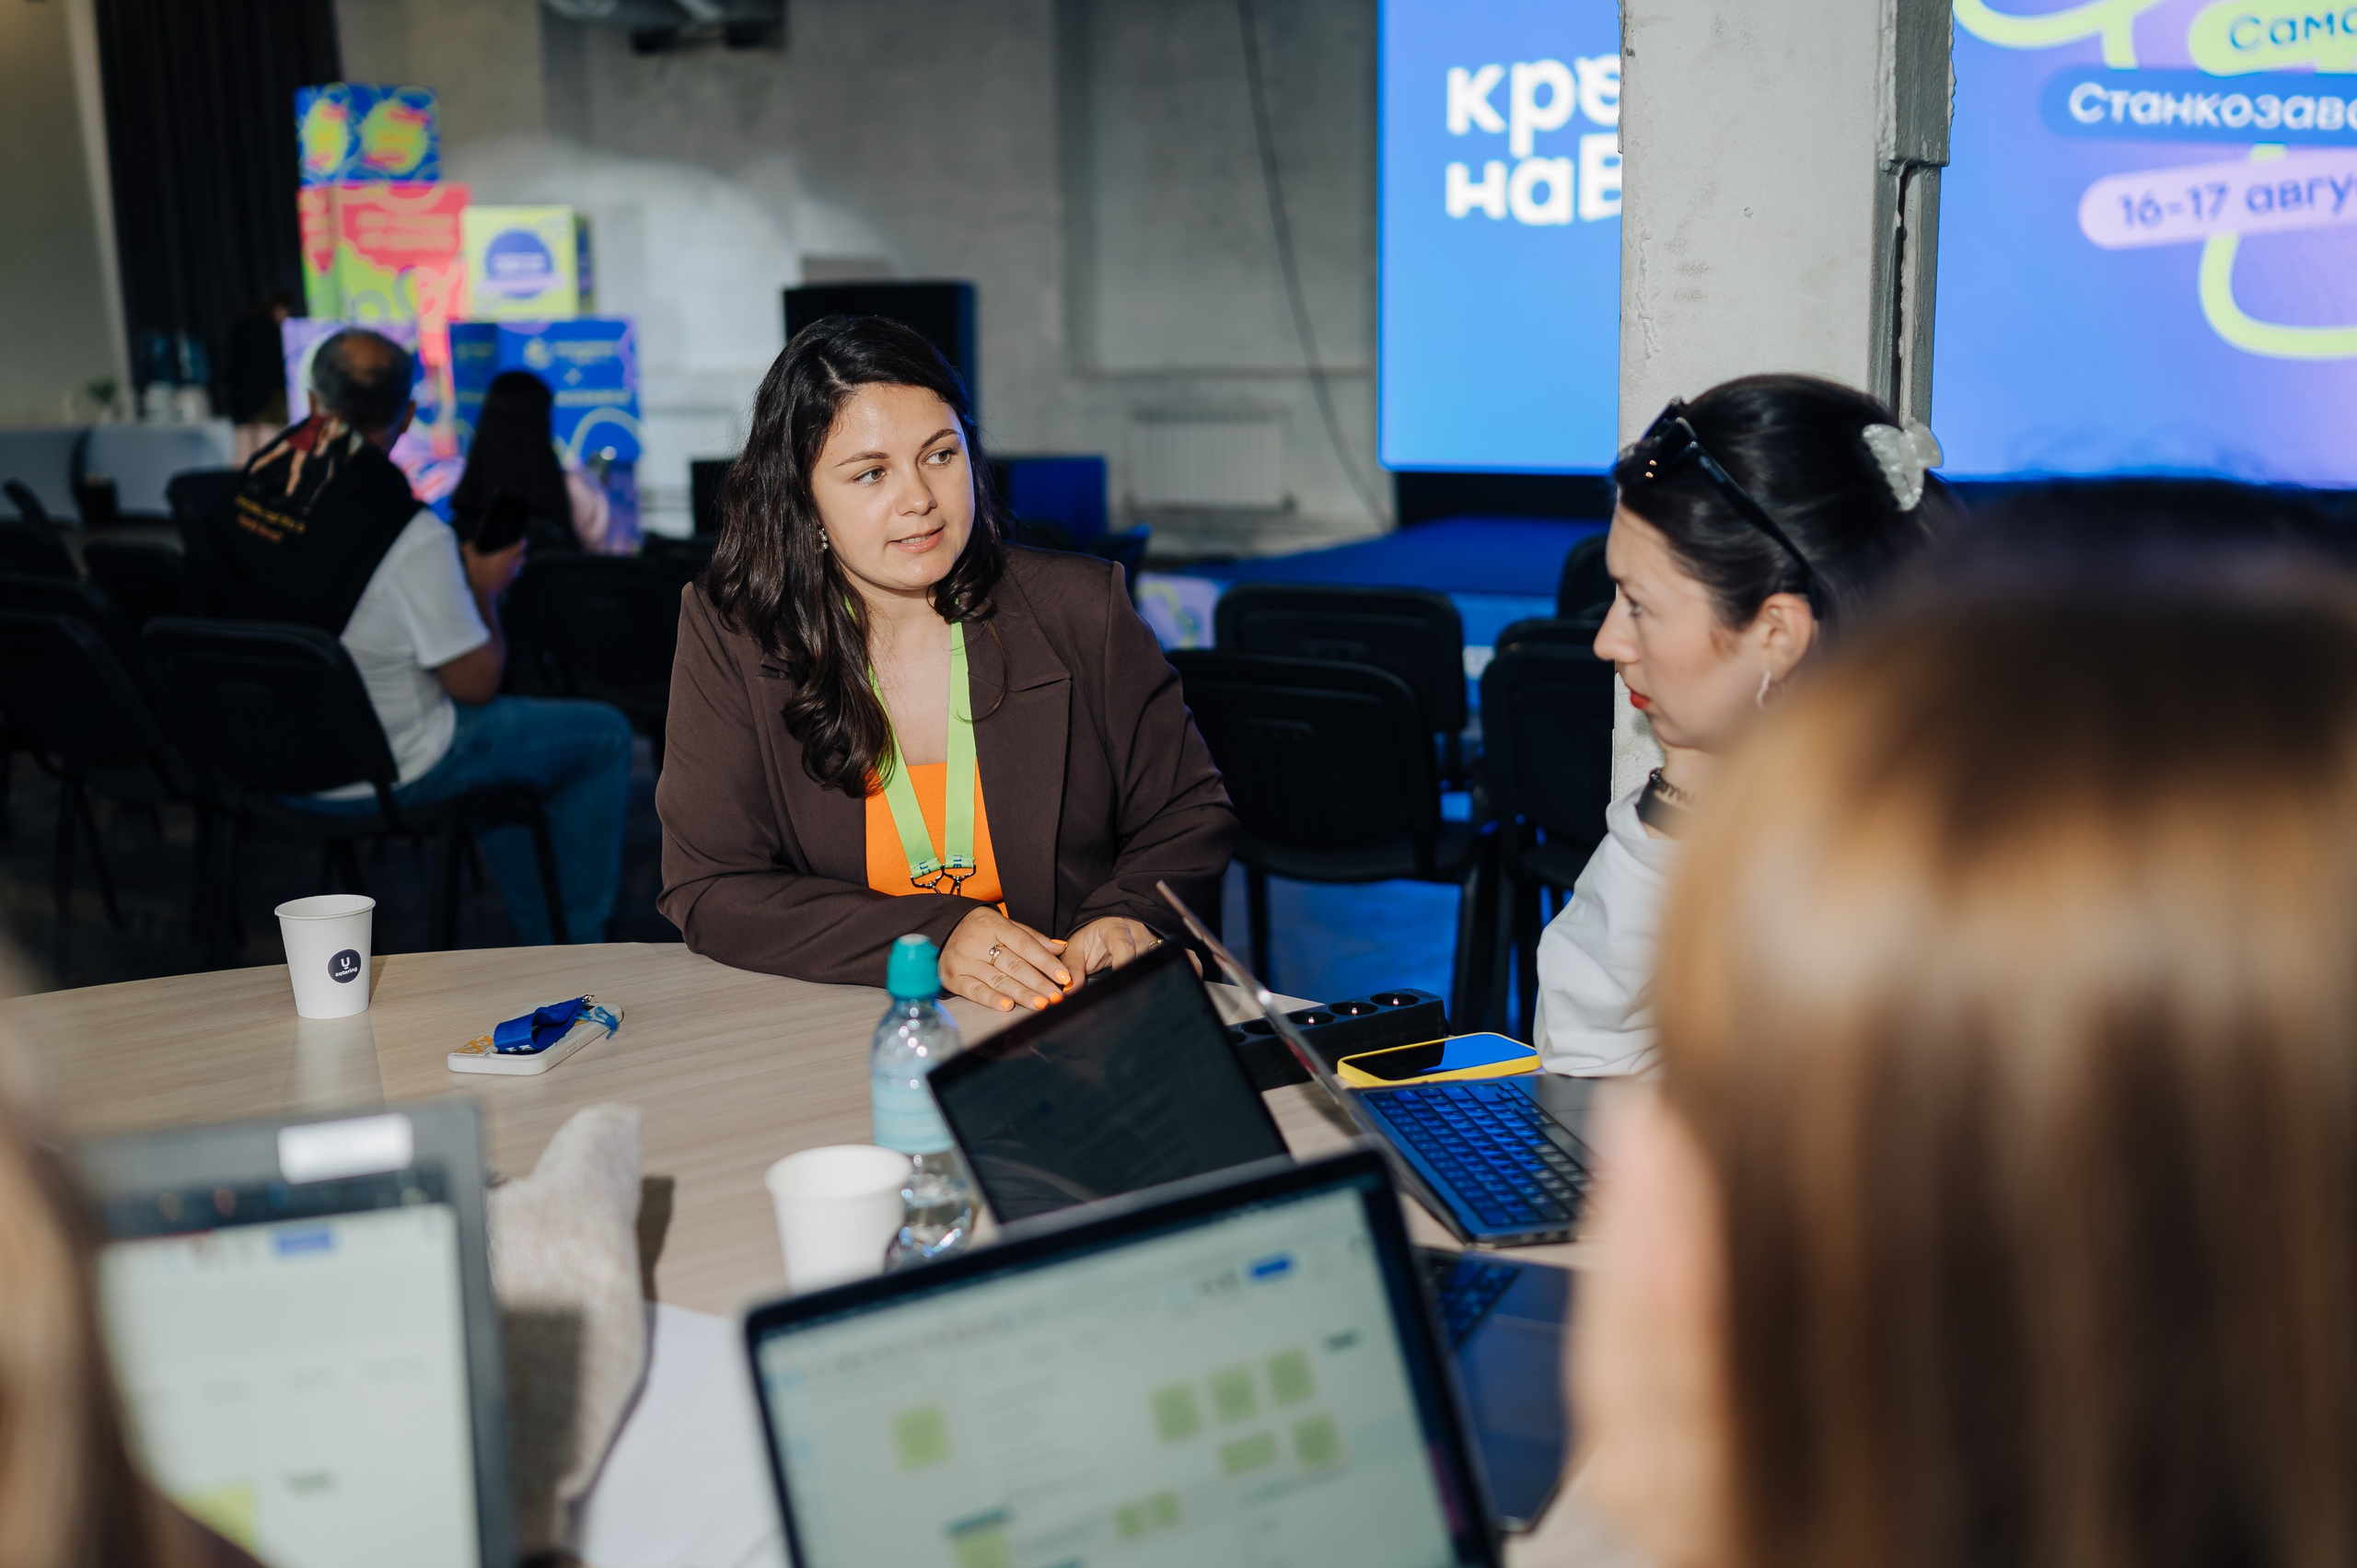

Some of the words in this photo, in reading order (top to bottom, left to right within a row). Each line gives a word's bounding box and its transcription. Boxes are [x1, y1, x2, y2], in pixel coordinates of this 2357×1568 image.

[2118, 182, 2226, 228] 16-17
[2246, 172, 2357, 215] авгу
[335, 967, 357, 977] catering
